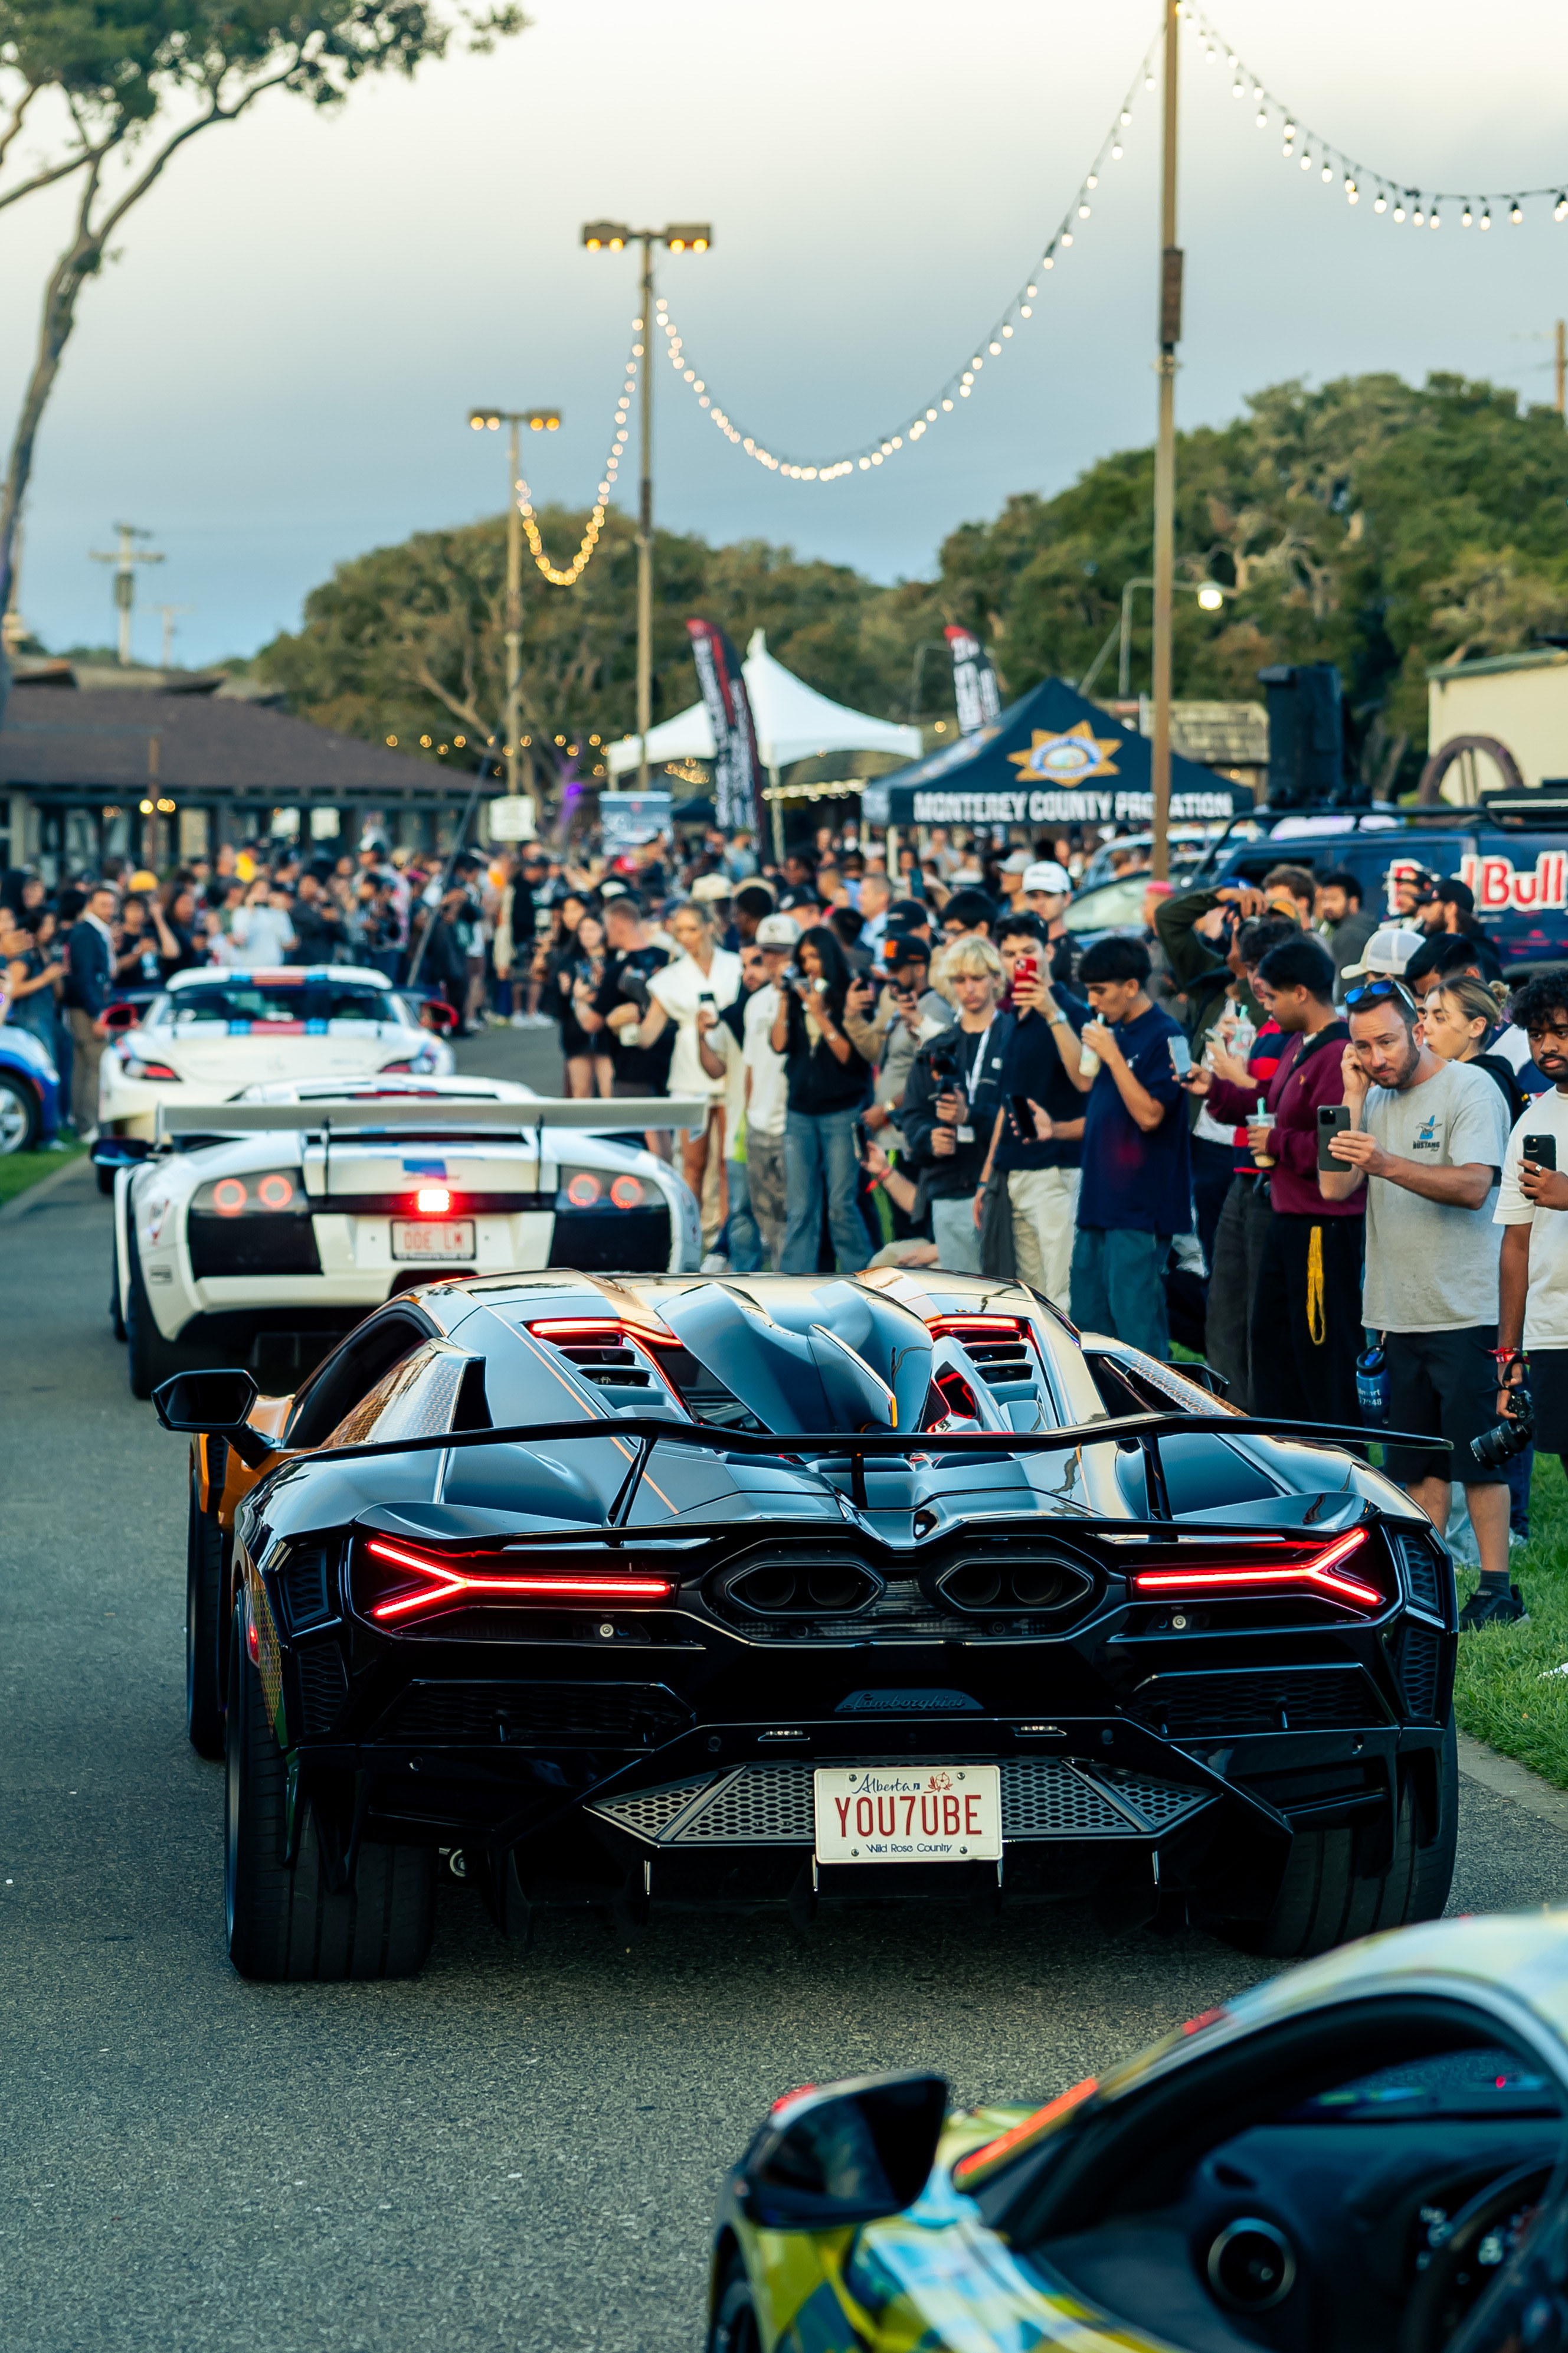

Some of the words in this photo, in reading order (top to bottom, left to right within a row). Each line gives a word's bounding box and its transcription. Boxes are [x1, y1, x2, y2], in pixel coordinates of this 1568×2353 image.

[914, 791, 1028, 822] MONTEREY
[1029, 790, 1113, 822] COUNTY
[1115, 790, 1233, 821] PROATION
[1481, 855, 1566, 909] Bull
[842, 1692, 966, 1711] Lamborghini
[852, 1774, 915, 1794] Alberta
[834, 1795, 982, 1837] YOU7UBE
[866, 1844, 888, 1853] Wild
[891, 1844, 914, 1852] Rose
[916, 1843, 952, 1853] Country
